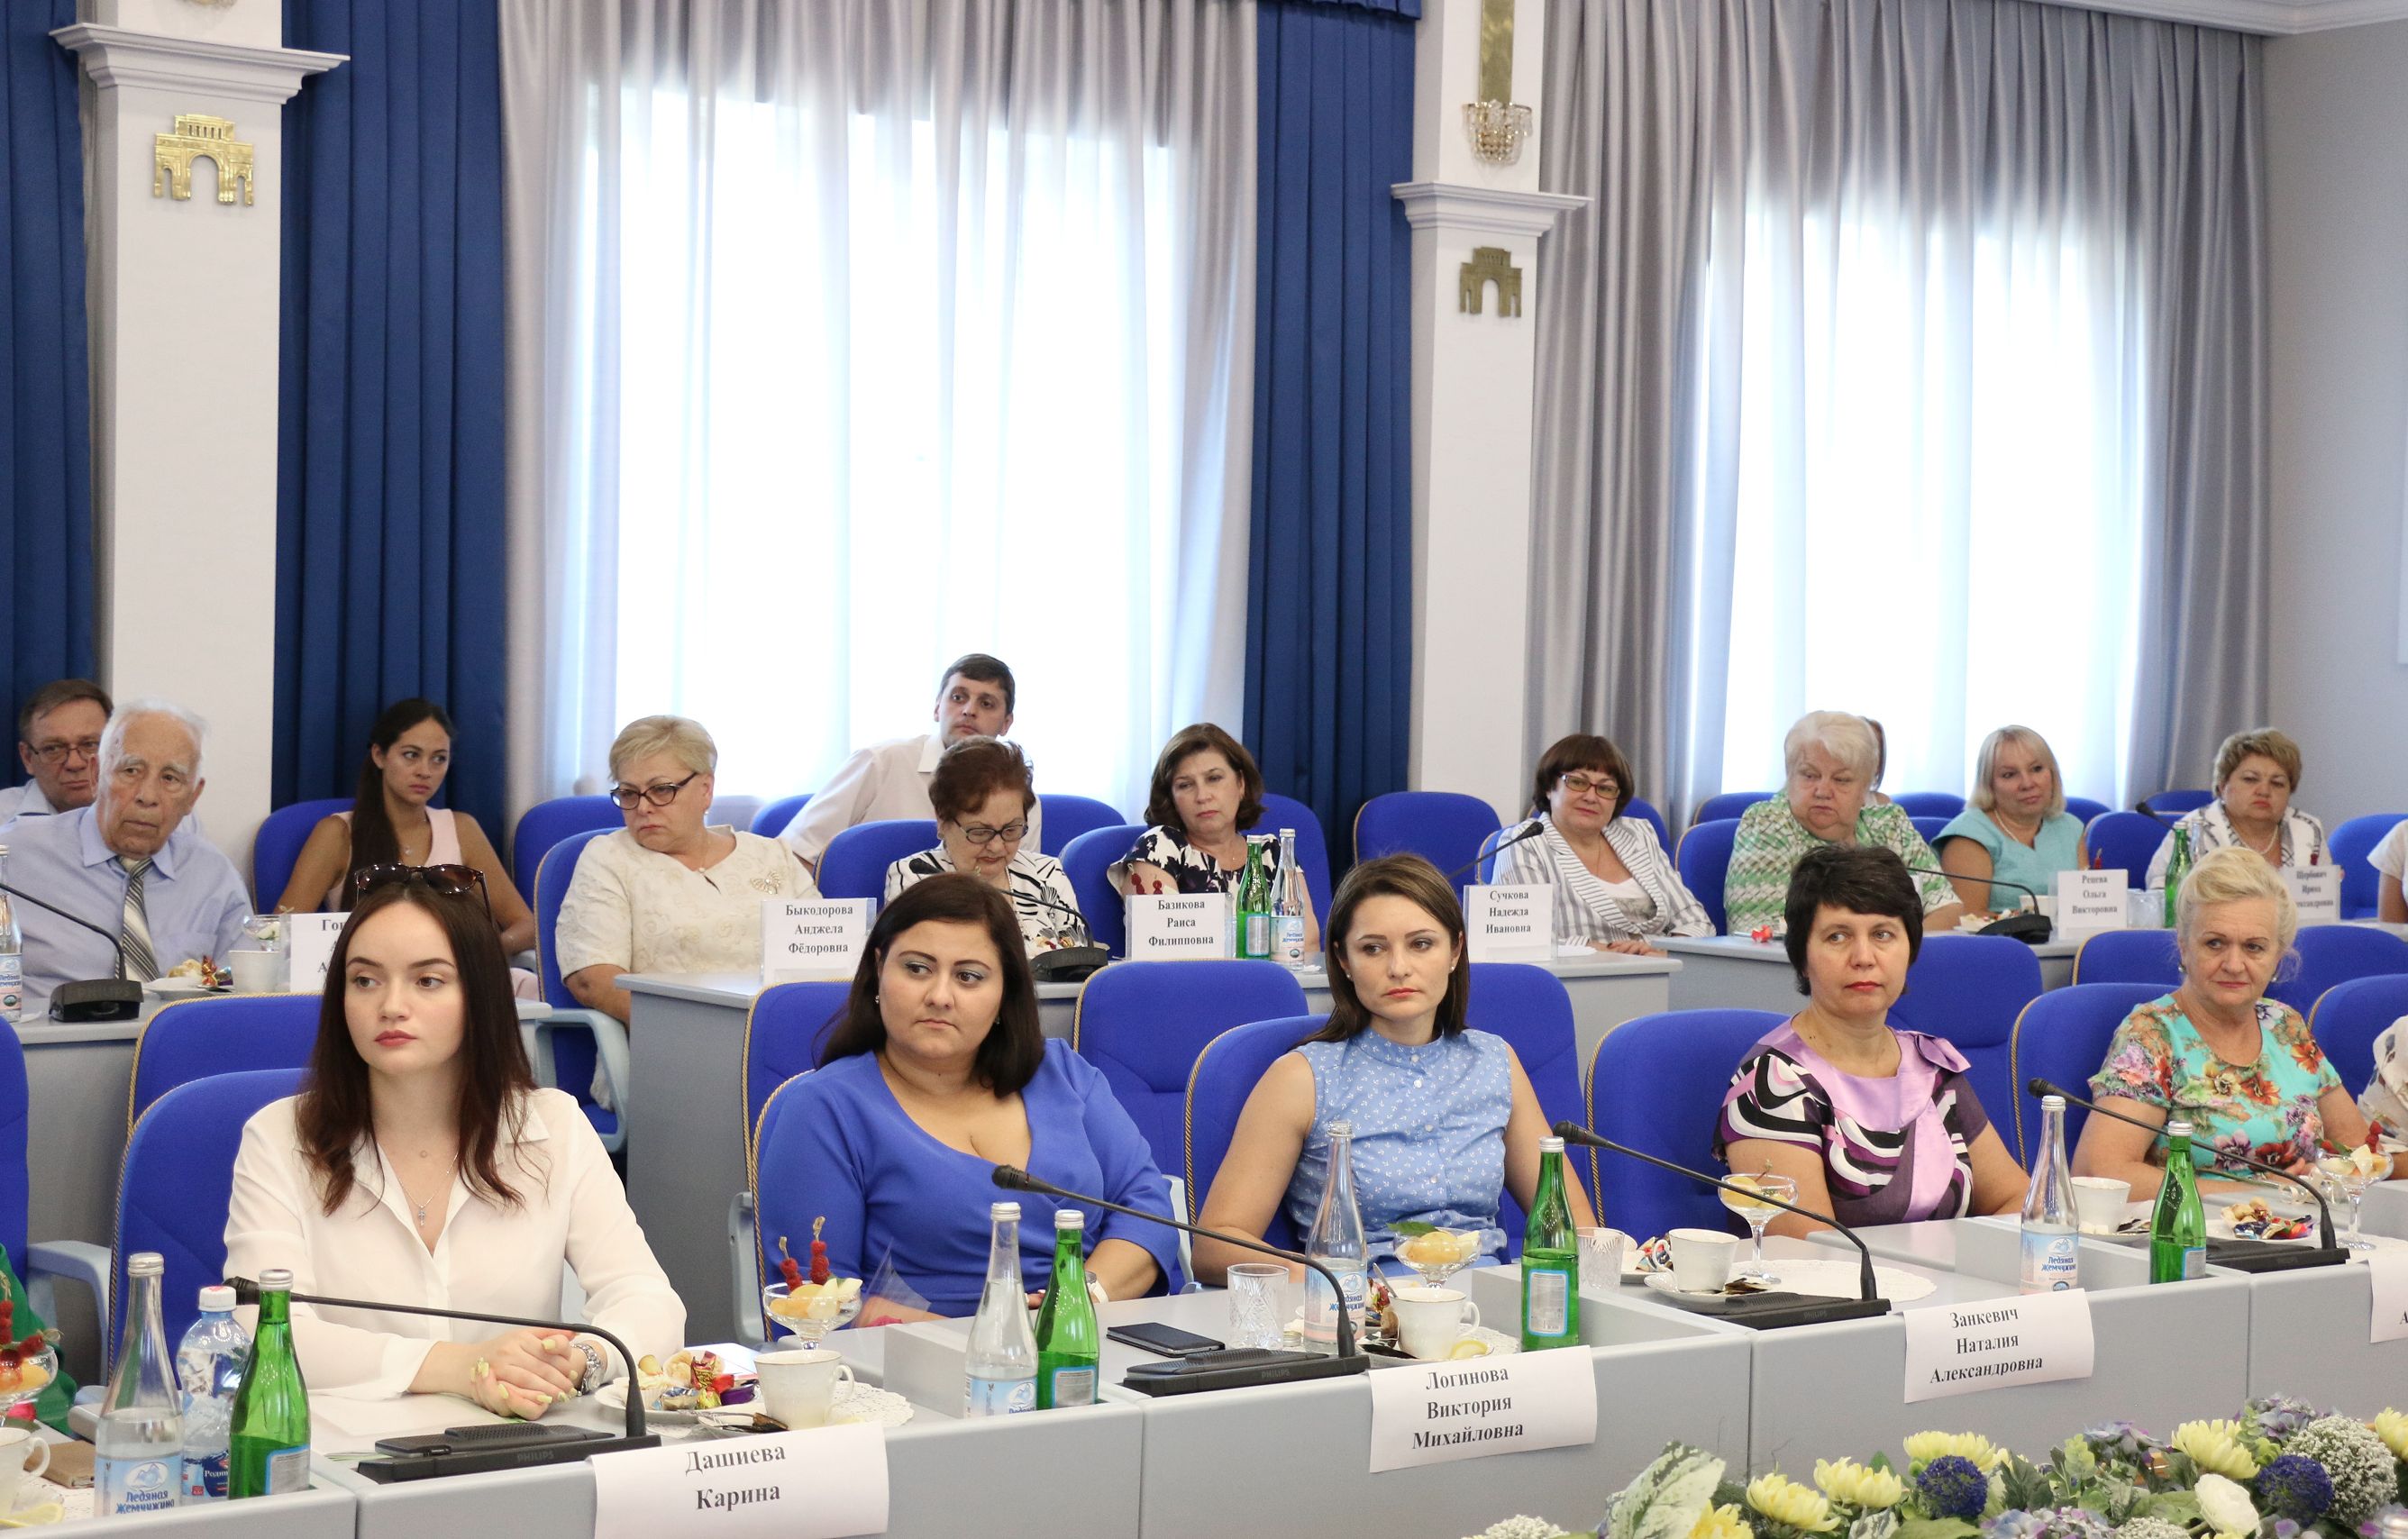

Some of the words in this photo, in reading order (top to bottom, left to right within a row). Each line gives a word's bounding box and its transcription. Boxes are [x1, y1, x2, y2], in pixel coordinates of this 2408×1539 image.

[1490, 891, 1528, 902] Сучкова
[2083, 890, 2106, 898] Ольга
[787, 905, 853, 917] Быкодорова
[1158, 900, 1204, 910] Базикова
[2073, 906, 2117, 915] Викторовна
[1490, 907, 1528, 916] Надежда
[1168, 918, 1195, 927] Раиса
[1487, 924, 1530, 933] Ивановна
[796, 924, 843, 934] Анджела
[1149, 936, 1213, 946] Филипповна
[789, 943, 848, 956] Фёдоровна
[1950, 1309, 2018, 1328] Занкевич
[1957, 1336, 2018, 1353] Наталия
[1929, 1357, 2042, 1383] Александровна
[1427, 1369, 1508, 1389] Логинова
[1427, 1398, 1510, 1419] Виктория
[1413, 1425, 1522, 1449] Михайловна
[517, 1449, 556, 1463] PHILIPS
[685, 1446, 786, 1476] Дашиева
[698, 1487, 780, 1511] Карина
